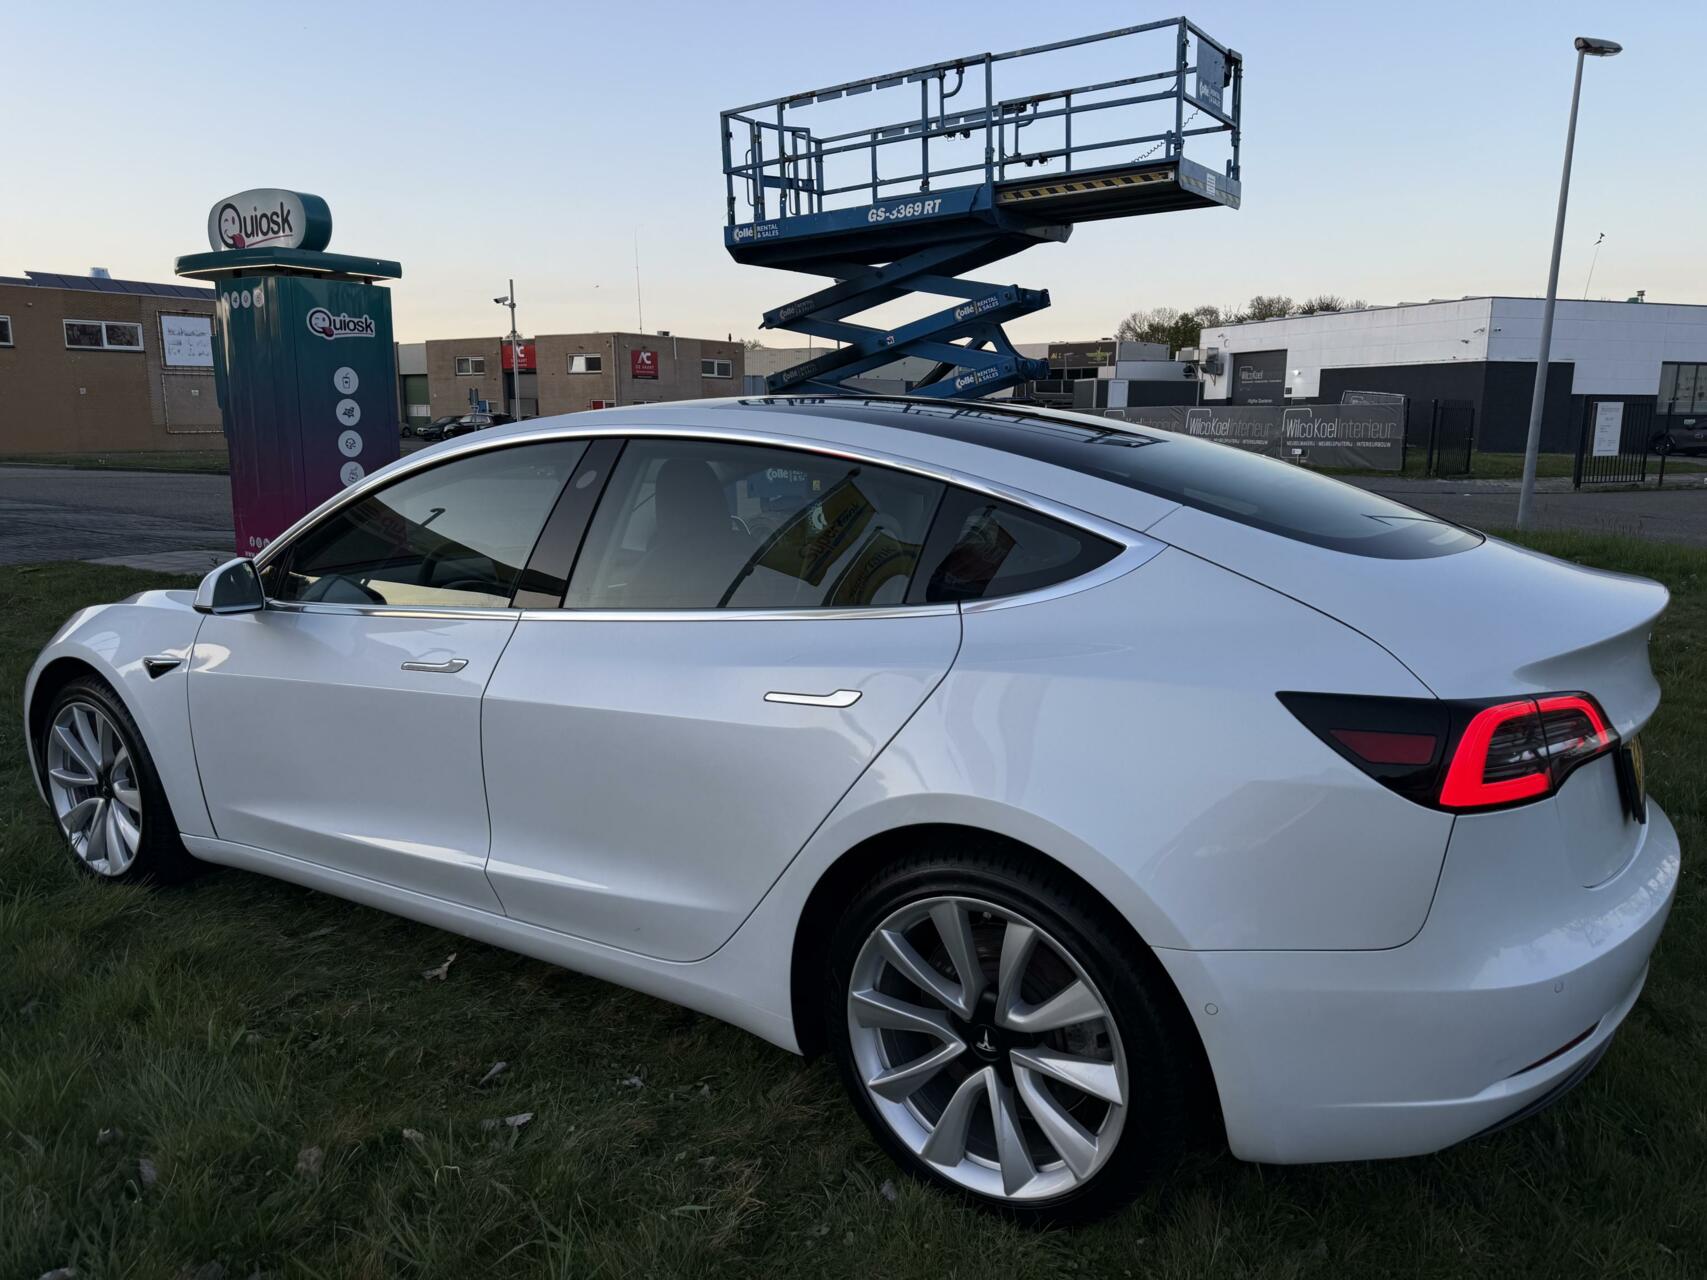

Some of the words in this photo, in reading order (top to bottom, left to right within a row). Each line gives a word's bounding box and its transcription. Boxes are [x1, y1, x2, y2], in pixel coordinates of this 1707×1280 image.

[218, 201, 293, 249] Quiosk
[757, 224, 778, 232] RENTAL
[309, 309, 374, 338] Quiosk
